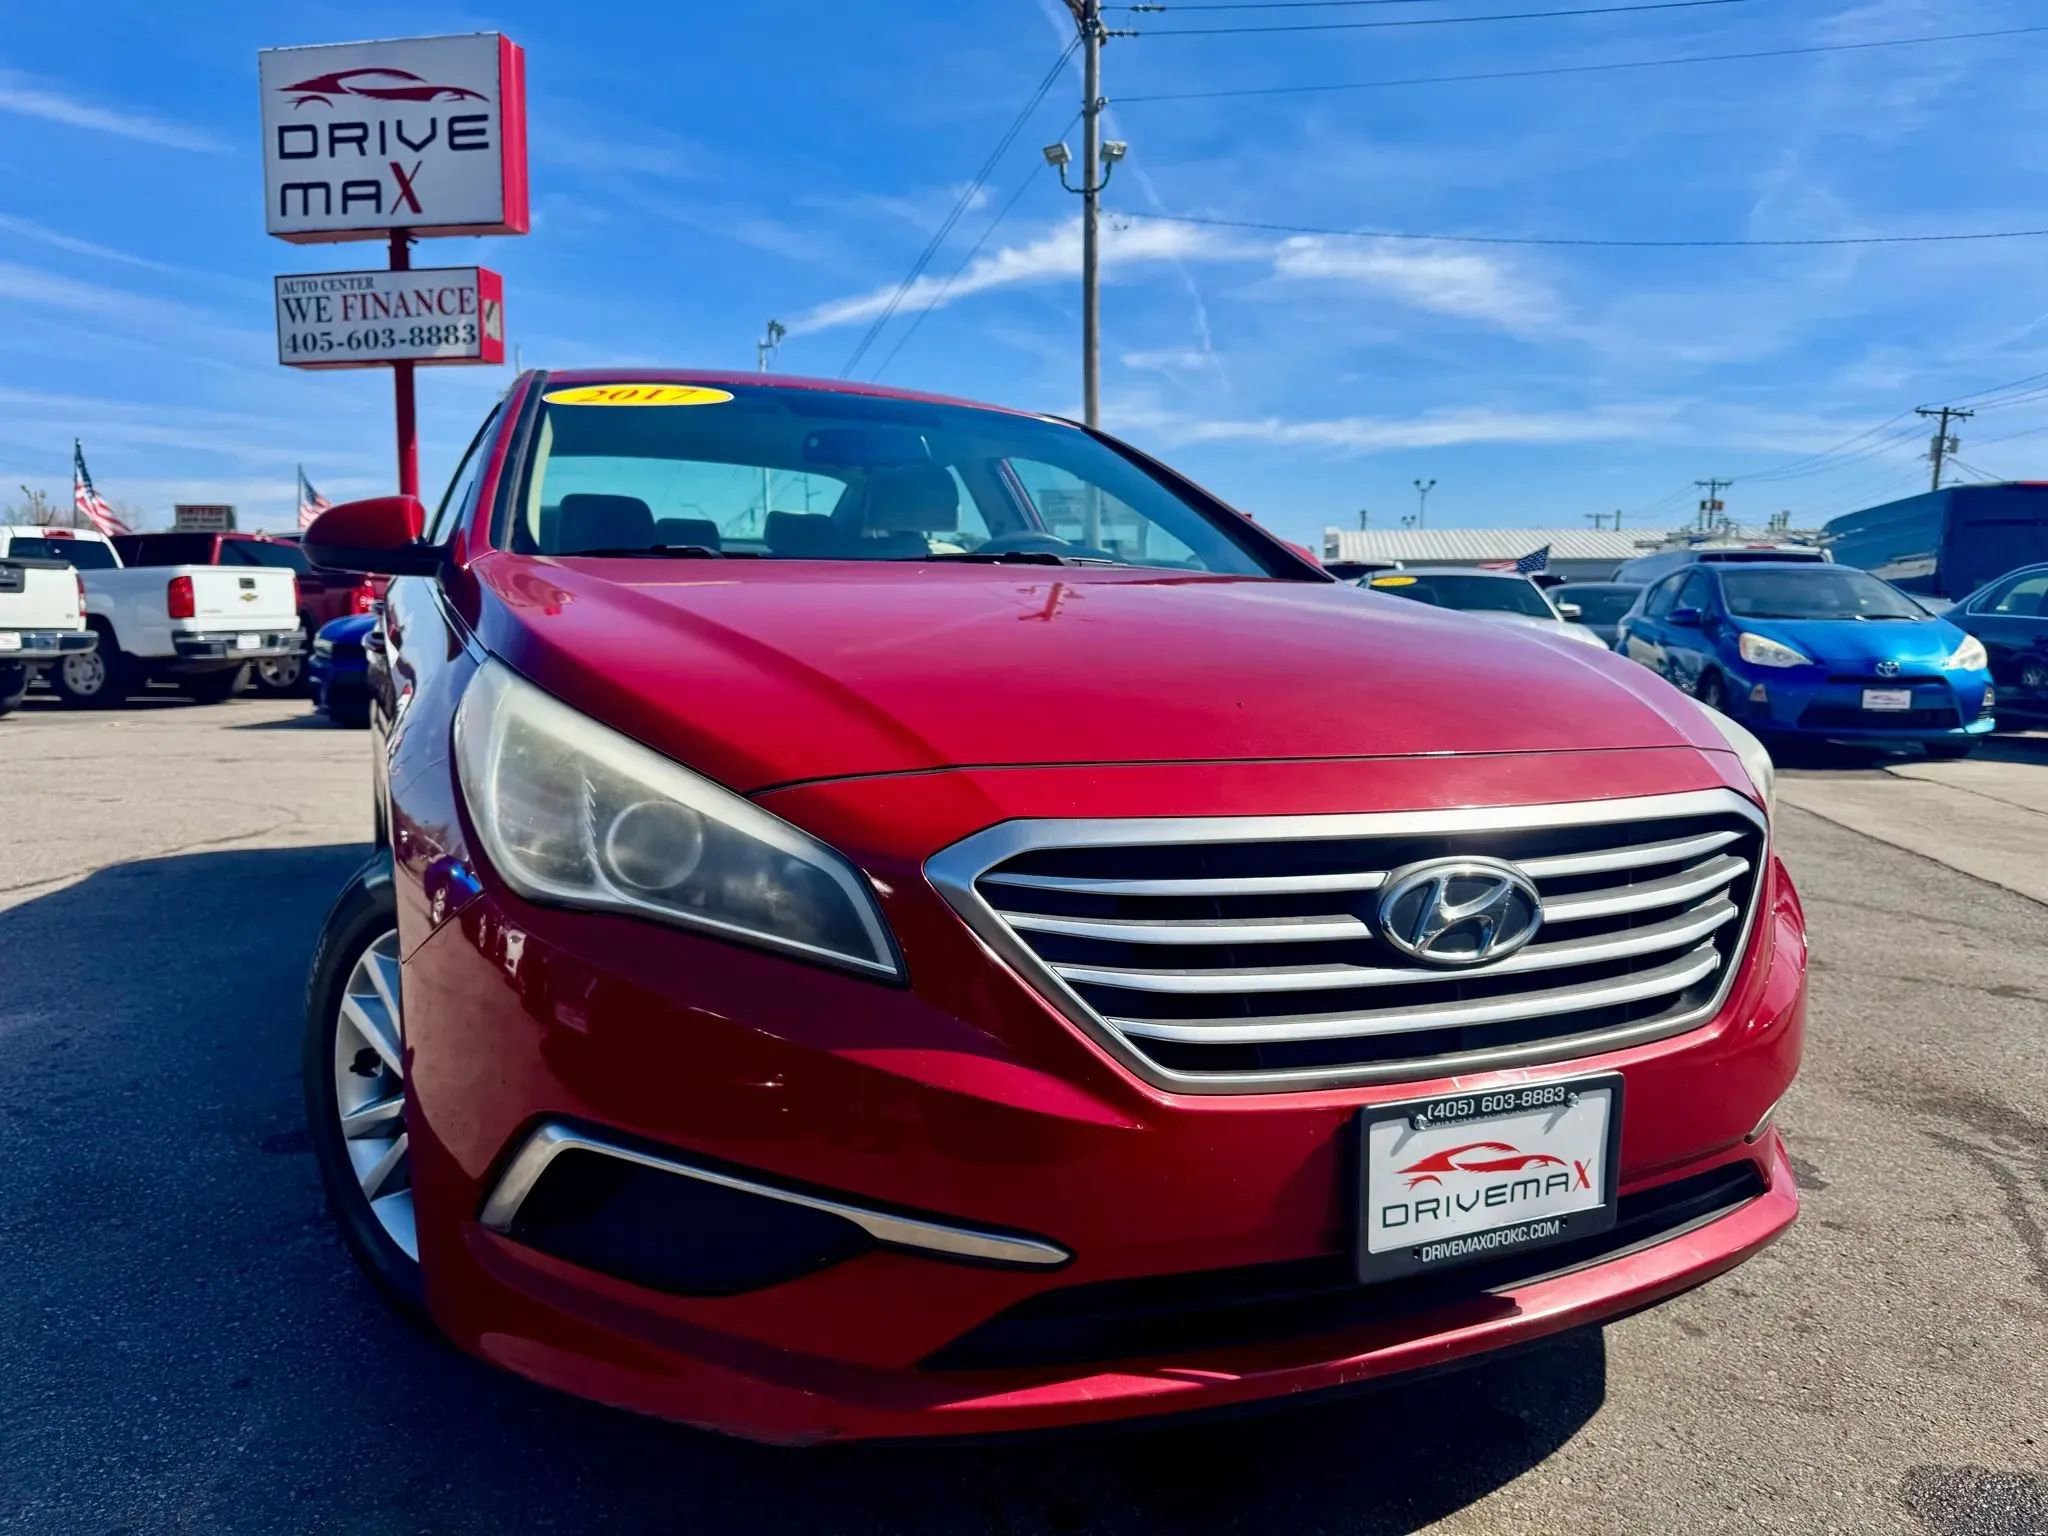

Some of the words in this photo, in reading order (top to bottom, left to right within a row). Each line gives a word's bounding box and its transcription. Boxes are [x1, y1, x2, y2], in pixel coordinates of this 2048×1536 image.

[278, 114, 489, 159] DRIVE
[281, 160, 422, 216] MAX
[282, 280, 319, 294] AUTO
[321, 277, 374, 292] CENTER
[282, 296, 333, 324] WE
[341, 287, 476, 321] FINANCE
[284, 324, 477, 354] 405-603-8883
[575, 389, 699, 402] 2017
[1427, 1099, 1475, 1119] (405)
[1481, 1086, 1565, 1112] 603-8883
[1382, 1159, 1592, 1229] DRIVEMAX
[1422, 1220, 1560, 1263] DRIVEMAXOFOKC.COM
